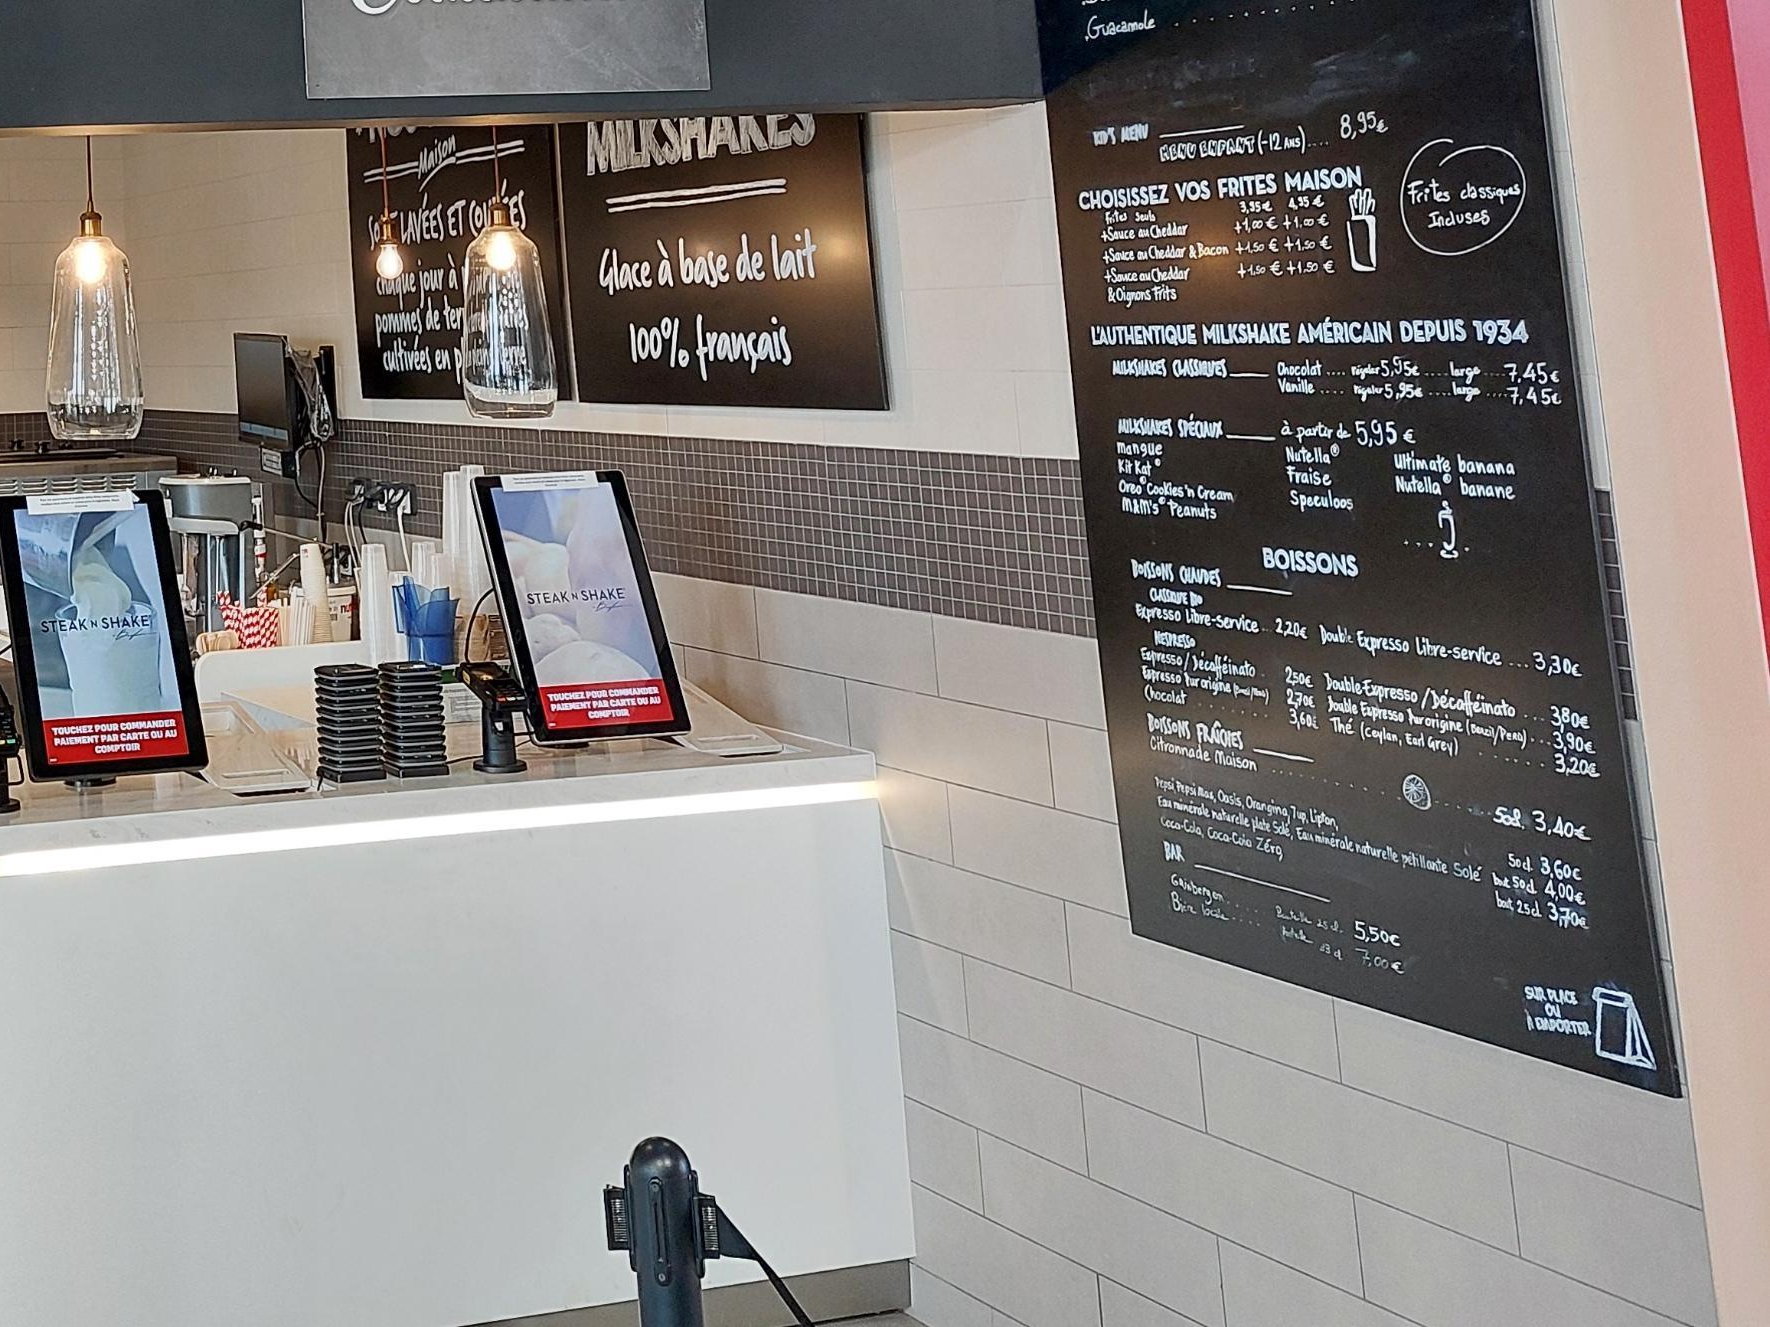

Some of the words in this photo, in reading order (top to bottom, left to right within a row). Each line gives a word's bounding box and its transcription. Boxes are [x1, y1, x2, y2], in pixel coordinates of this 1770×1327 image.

[586, 113, 816, 177] MILKSHAKES
[417, 134, 457, 180] Maison
[1078, 184, 1169, 210] CHOISISSEZ
[1174, 180, 1211, 202] VOS
[1217, 173, 1277, 199] FRITES
[1284, 165, 1362, 193] MAISON
[1407, 178, 1451, 205] Frites
[1460, 182, 1521, 205] classiques
[400, 192, 445, 245] LAVÉES
[447, 199, 467, 237] ET
[598, 248, 652, 295] Glace
[656, 239, 674, 287] à
[678, 237, 730, 288] base
[736, 233, 766, 282] de
[770, 228, 818, 280] lait
[1197, 243, 1229, 258] Bacon
[417, 259, 445, 309] jour
[447, 253, 460, 290] à
[375, 307, 423, 348] pommes
[426, 297, 442, 332] de
[1090, 323, 1197, 346] L'AUTHENTIQUE
[1202, 322, 1291, 345] MILKSHAKE
[1297, 317, 1392, 344] AMÉRICAIN
[1399, 319, 1467, 344] DEPUIS
[1472, 319, 1529, 345] 1934
[383, 333, 432, 373] cultivées
[435, 348, 451, 371] en
[630, 317, 690, 368] 100%
[696, 314, 792, 382] français
[1277, 359, 1323, 376] Chocolat
[1277, 377, 1316, 394] Vanille
[1286, 465, 1332, 486] Fraise
[1457, 453, 1516, 476] banana
[1460, 476, 1516, 500] banane
[1289, 490, 1354, 512] Speculoos
[1261, 547, 1359, 577] BOISSONS
[527, 591, 570, 605] STEAK
[571, 592, 579, 601] N
[580, 588, 626, 601] SHAKE
[41, 618, 88, 633] STEAK
[91, 620, 98, 628] N
[101, 614, 150, 629] SHAKE
[1356, 630, 1409, 657] Expresso
[547, 691, 586, 702] TOUCHEZ
[586, 689, 609, 699] POUR
[609, 686, 660, 697] COMMANDER
[550, 701, 591, 712] PAIEMENT
[610, 697, 637, 707] CARTE
[51, 725, 94, 736] TOUCHEZ
[95, 723, 119, 733] POUR
[120, 719, 177, 731] COMMANDER
[1330, 716, 1355, 736] Thé
[54, 734, 100, 747] PAIEMENT
[101, 733, 119, 743] PAR
[120, 731, 149, 741] CARTE
[151, 730, 164, 739] OU
[165, 729, 177, 738] AU
[94, 742, 141, 754] COMPTOIR
[1214, 752, 1258, 772] Maison
